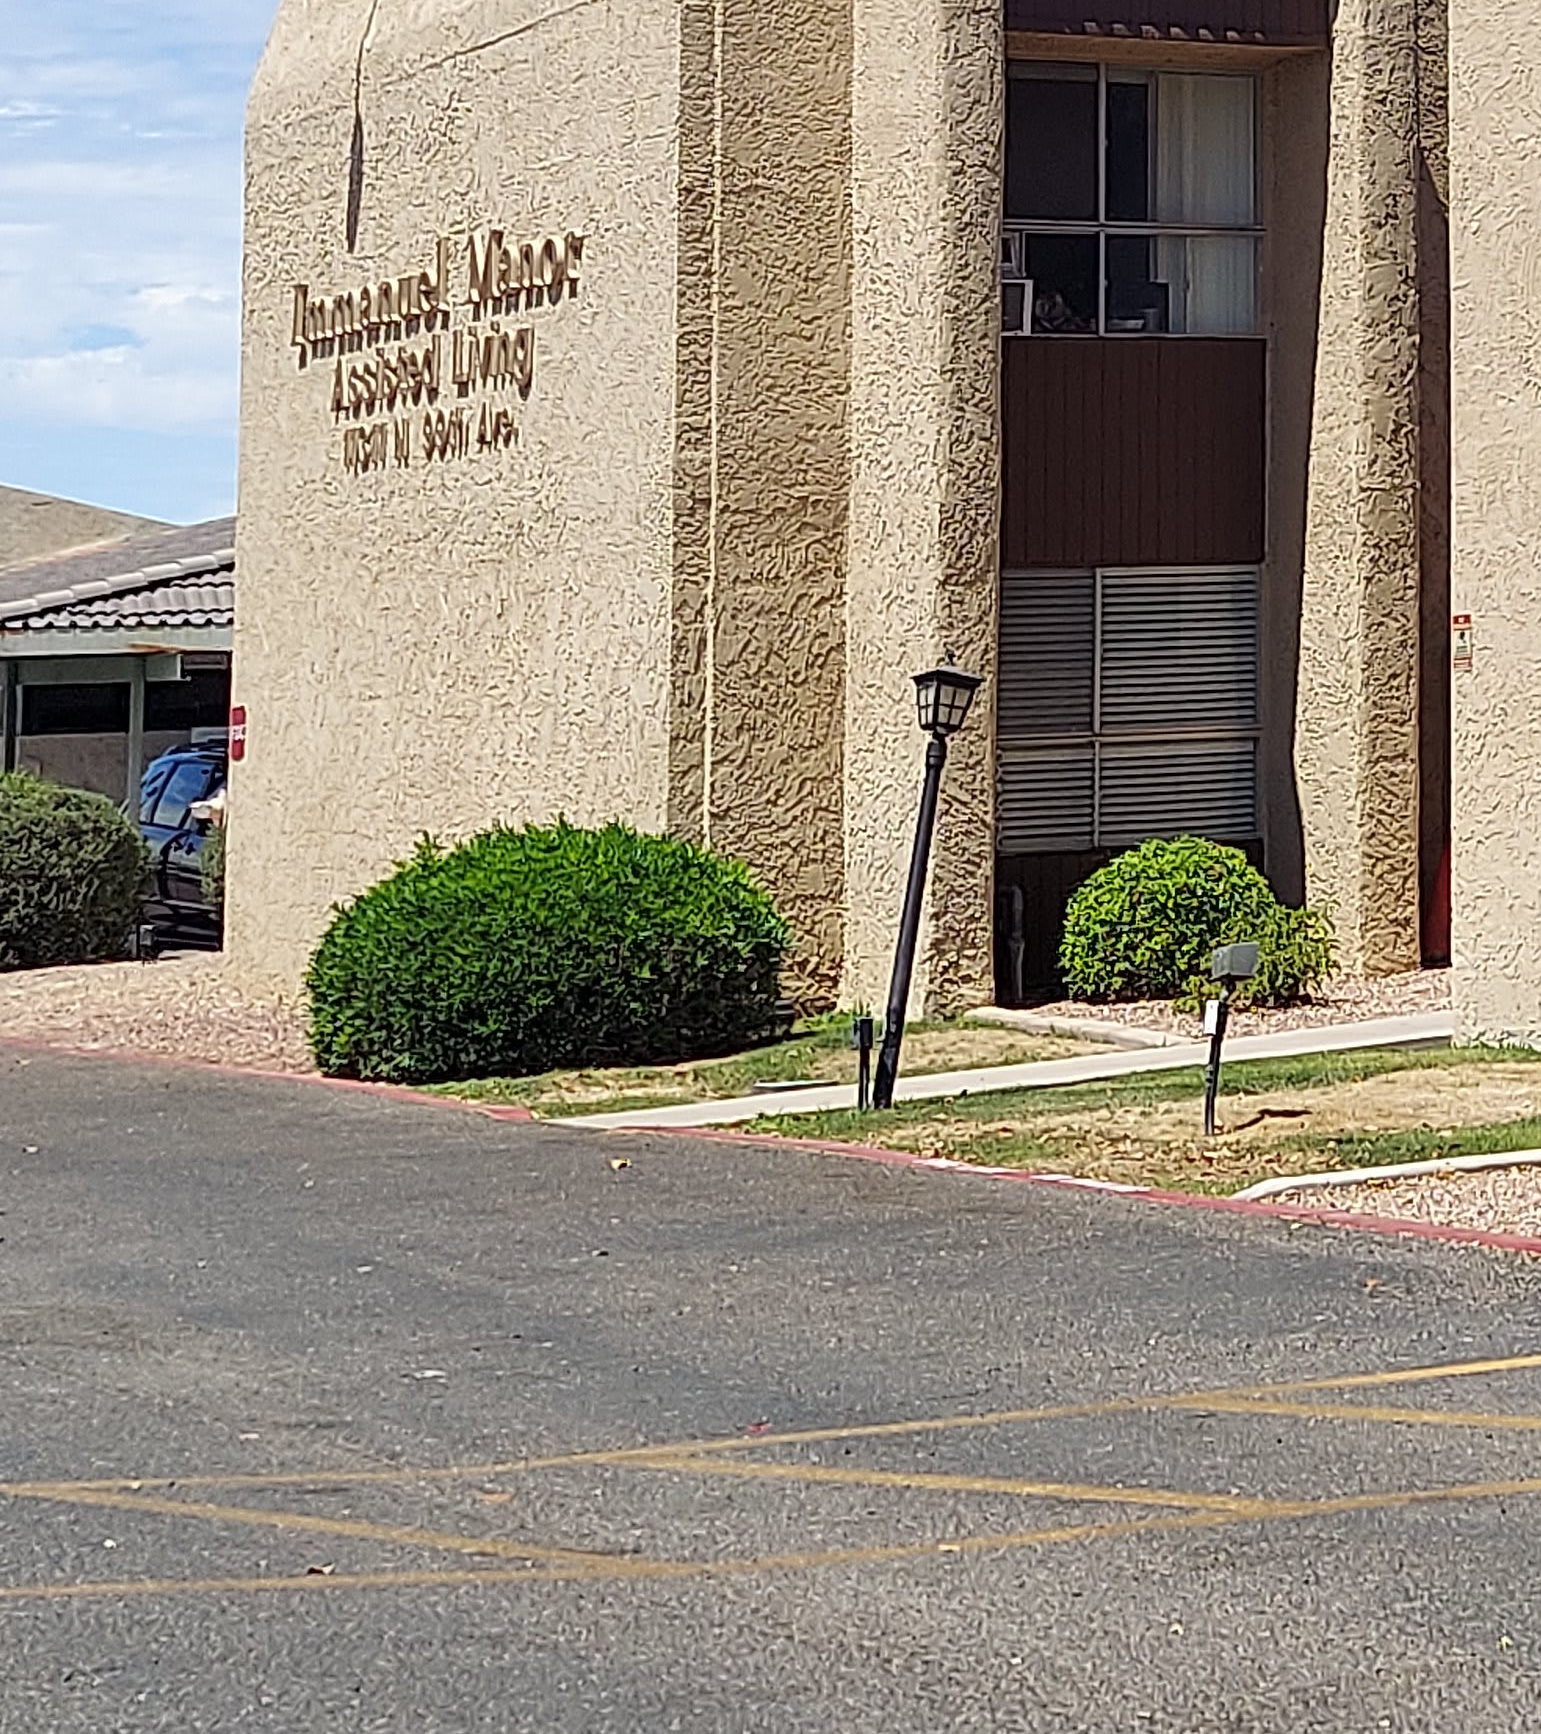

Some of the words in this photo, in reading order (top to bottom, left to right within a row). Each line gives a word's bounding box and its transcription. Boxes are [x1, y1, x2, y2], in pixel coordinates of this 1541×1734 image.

[291, 236, 450, 354] Immanuel
[465, 228, 584, 306] Manor
[331, 334, 440, 412] Assisted
[452, 320, 536, 396] Living
